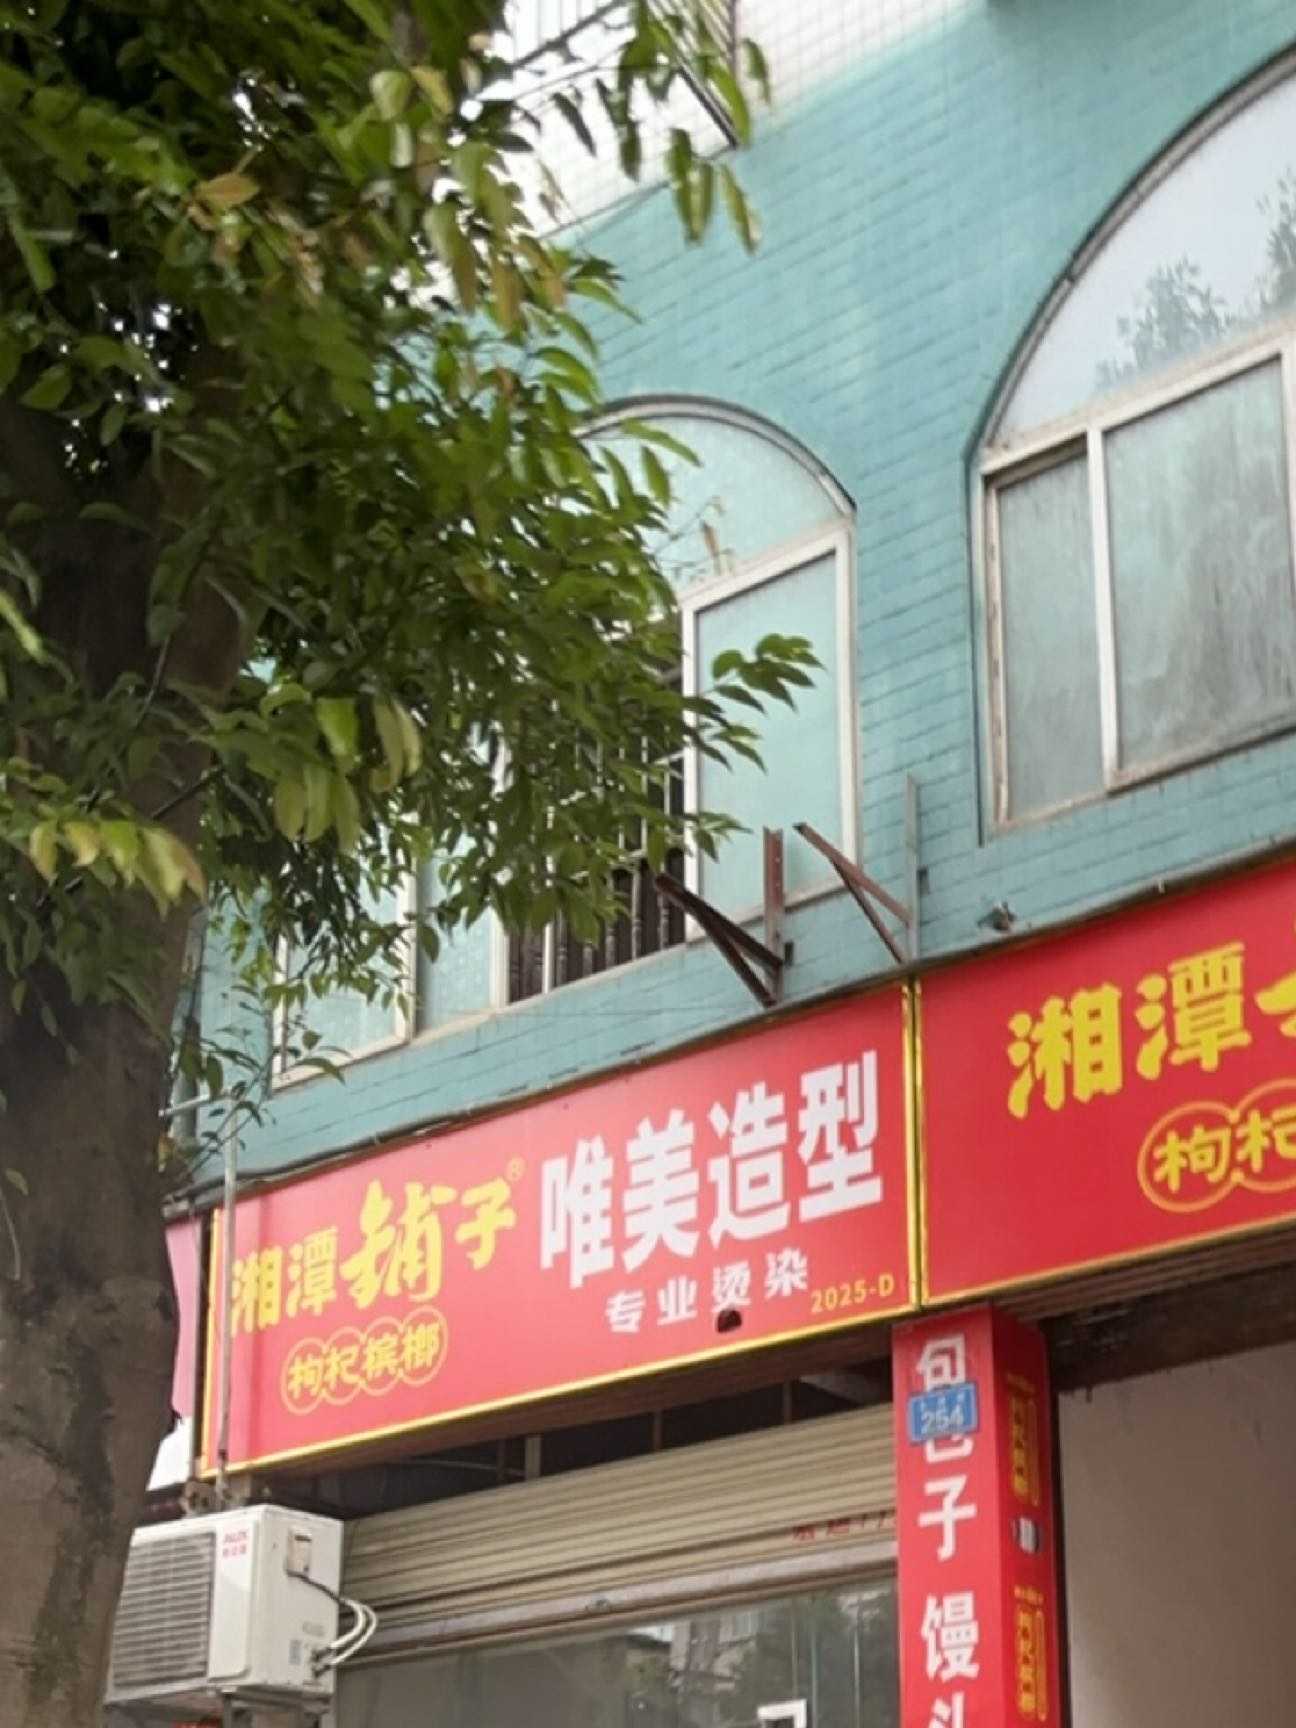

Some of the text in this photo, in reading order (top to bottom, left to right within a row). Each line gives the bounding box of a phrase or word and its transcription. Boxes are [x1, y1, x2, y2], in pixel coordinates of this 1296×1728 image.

[539, 1051, 884, 1288] 唯美造型
[230, 1175, 517, 1336] 湘潭铺子
[604, 1249, 810, 1334] 专业烫染
[810, 1273, 895, 1315] 2025-D
[286, 1325, 441, 1401] 枸杞槟榔
